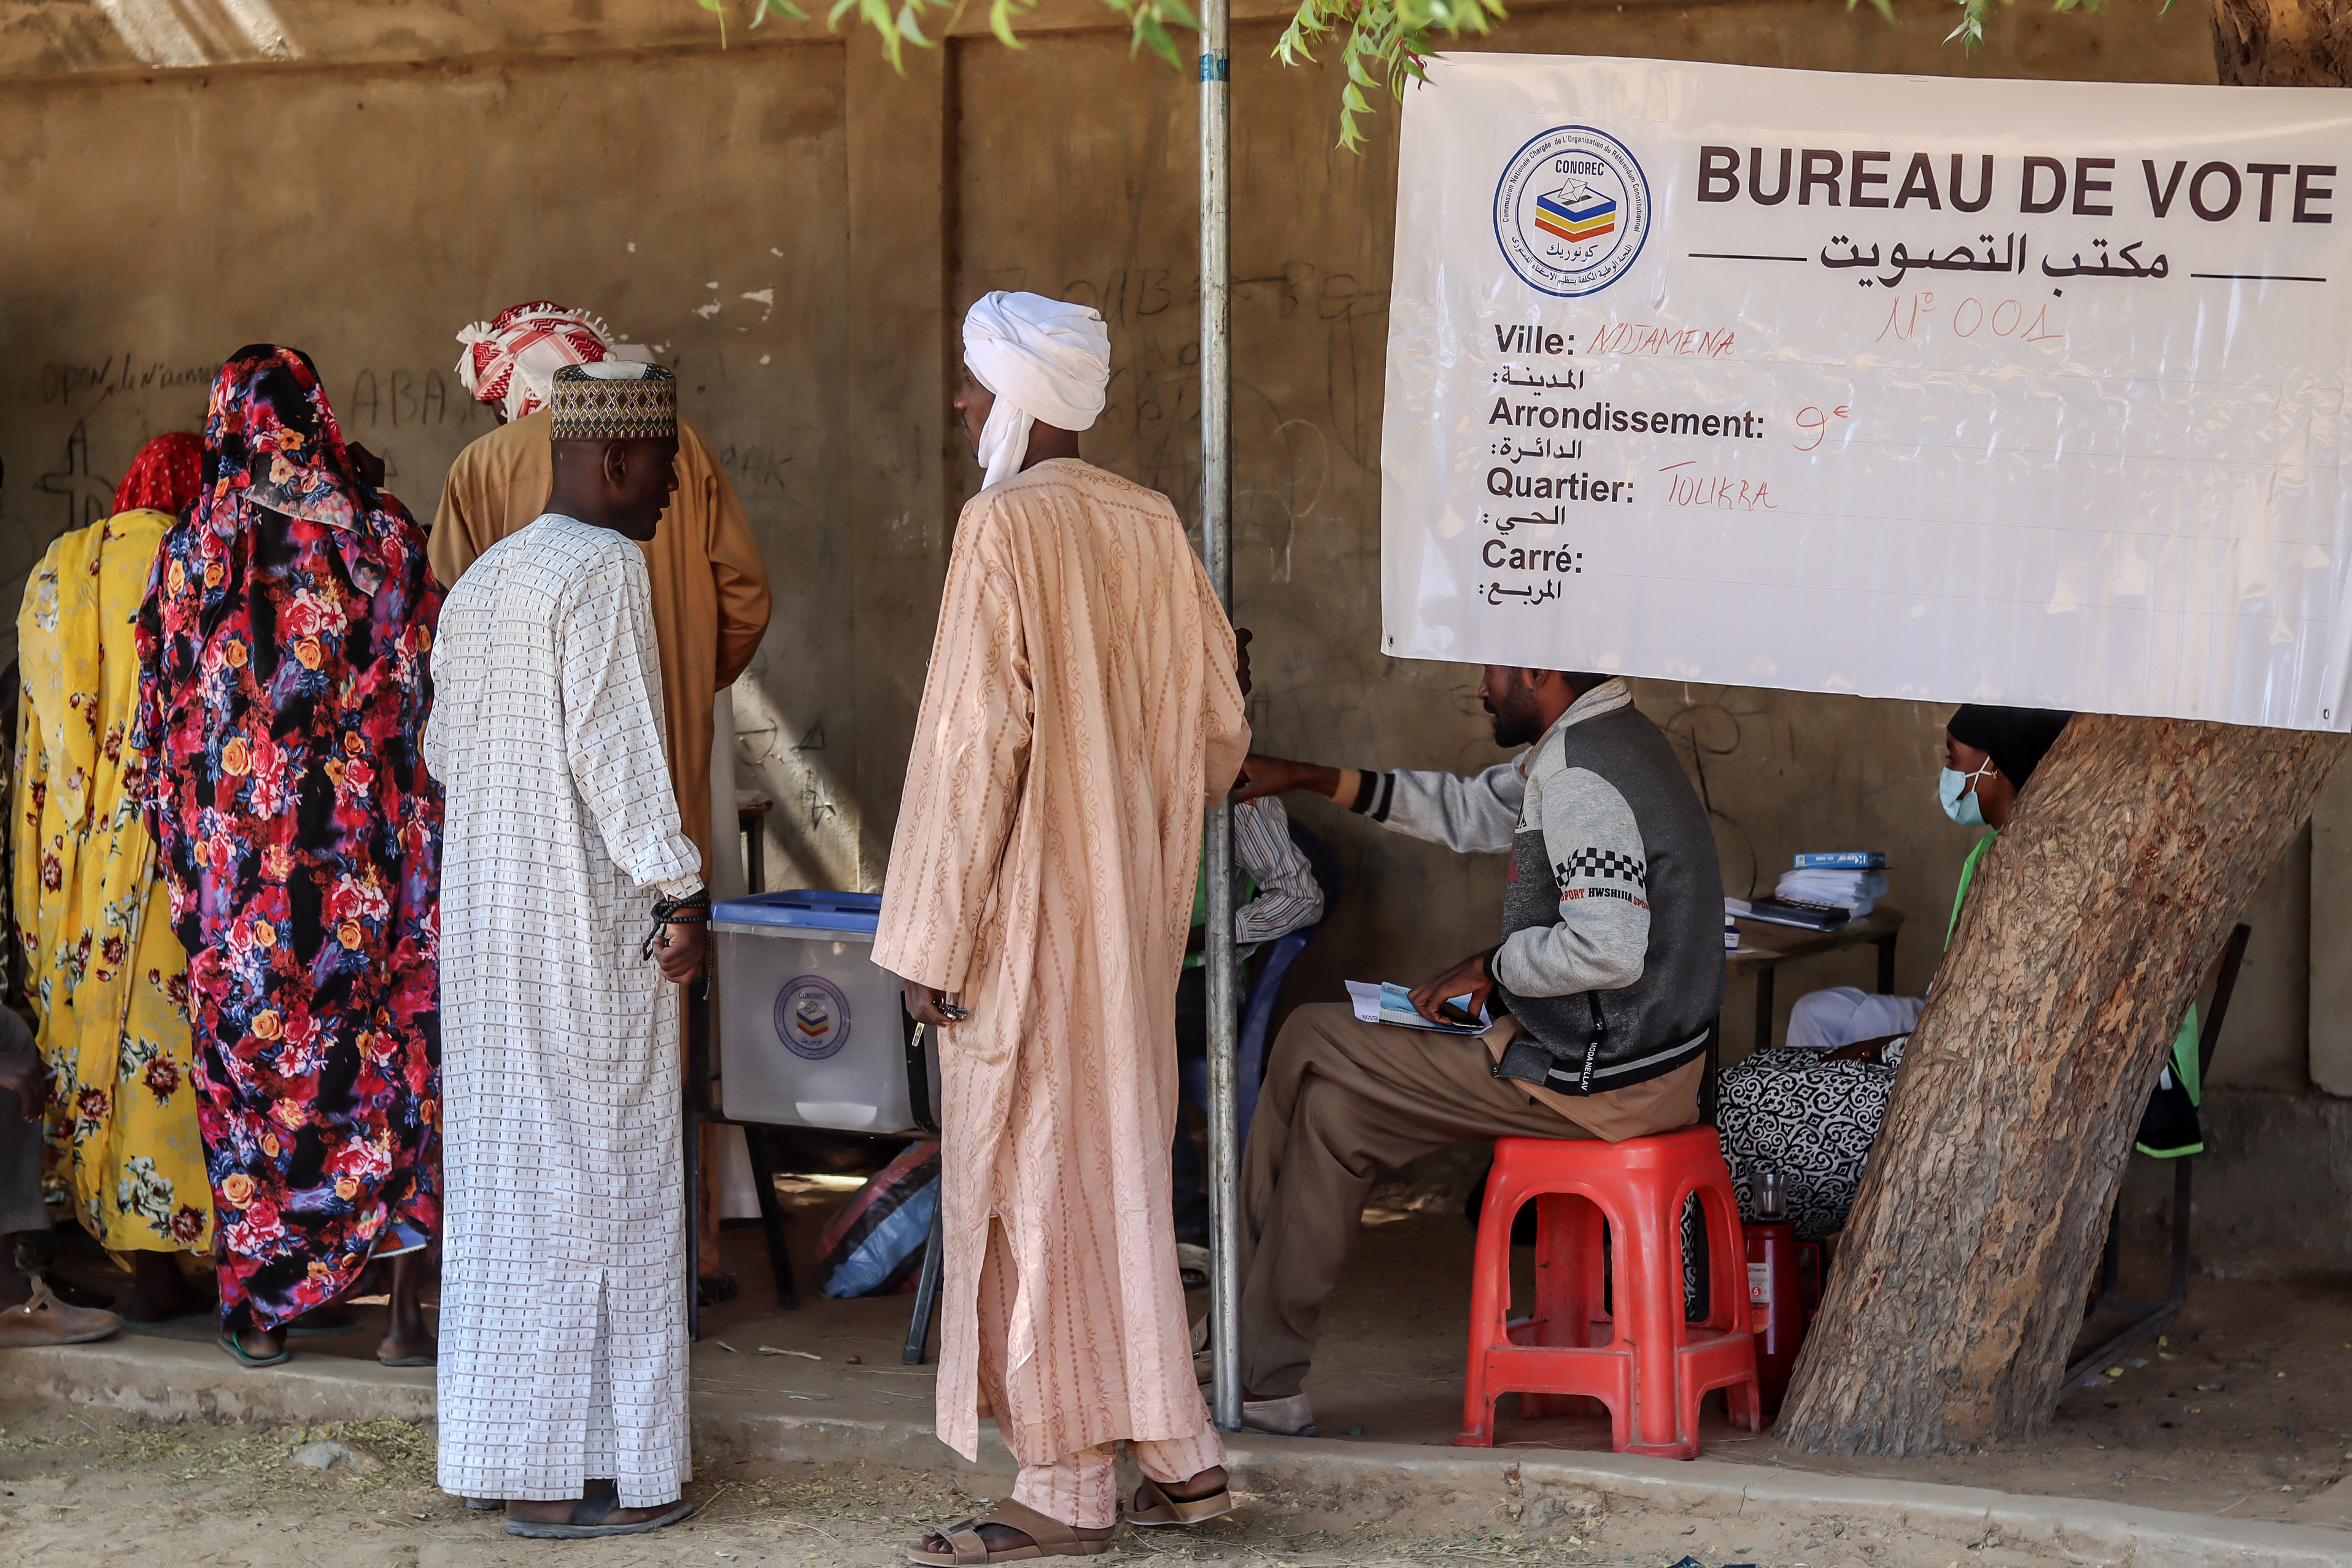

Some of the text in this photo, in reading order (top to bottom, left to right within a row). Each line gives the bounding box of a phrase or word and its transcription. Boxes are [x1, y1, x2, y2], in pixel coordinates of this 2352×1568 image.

[1555, 160, 1604, 176] CONOREC
[1698, 145, 2337, 224] BUREAU DE VOTE
[1503, 185, 1514, 222] Commission
[1510, 158, 1530, 184] Nationale
[1529, 142, 1551, 159] Chargée
[1611, 150, 1636, 183] Référendum
[1633, 183, 1643, 233] Constitutionnel
[1546, 242, 1598, 262] كونوريك
[1599, 260, 1619, 277] الوطنية
[1618, 244, 1633, 263] اللجنة
[1820, 231, 2169, 298] مكتب التصويت
[1578, 272, 1598, 284] المكلفة
[1954, 297, 2063, 342] 001
[1494, 324, 1575, 355] Ville:
[1488, 397, 1765, 439] Arrondissement:
[1486, 466, 1634, 503] Quartier:
[1482, 539, 1583, 574] Carré:
